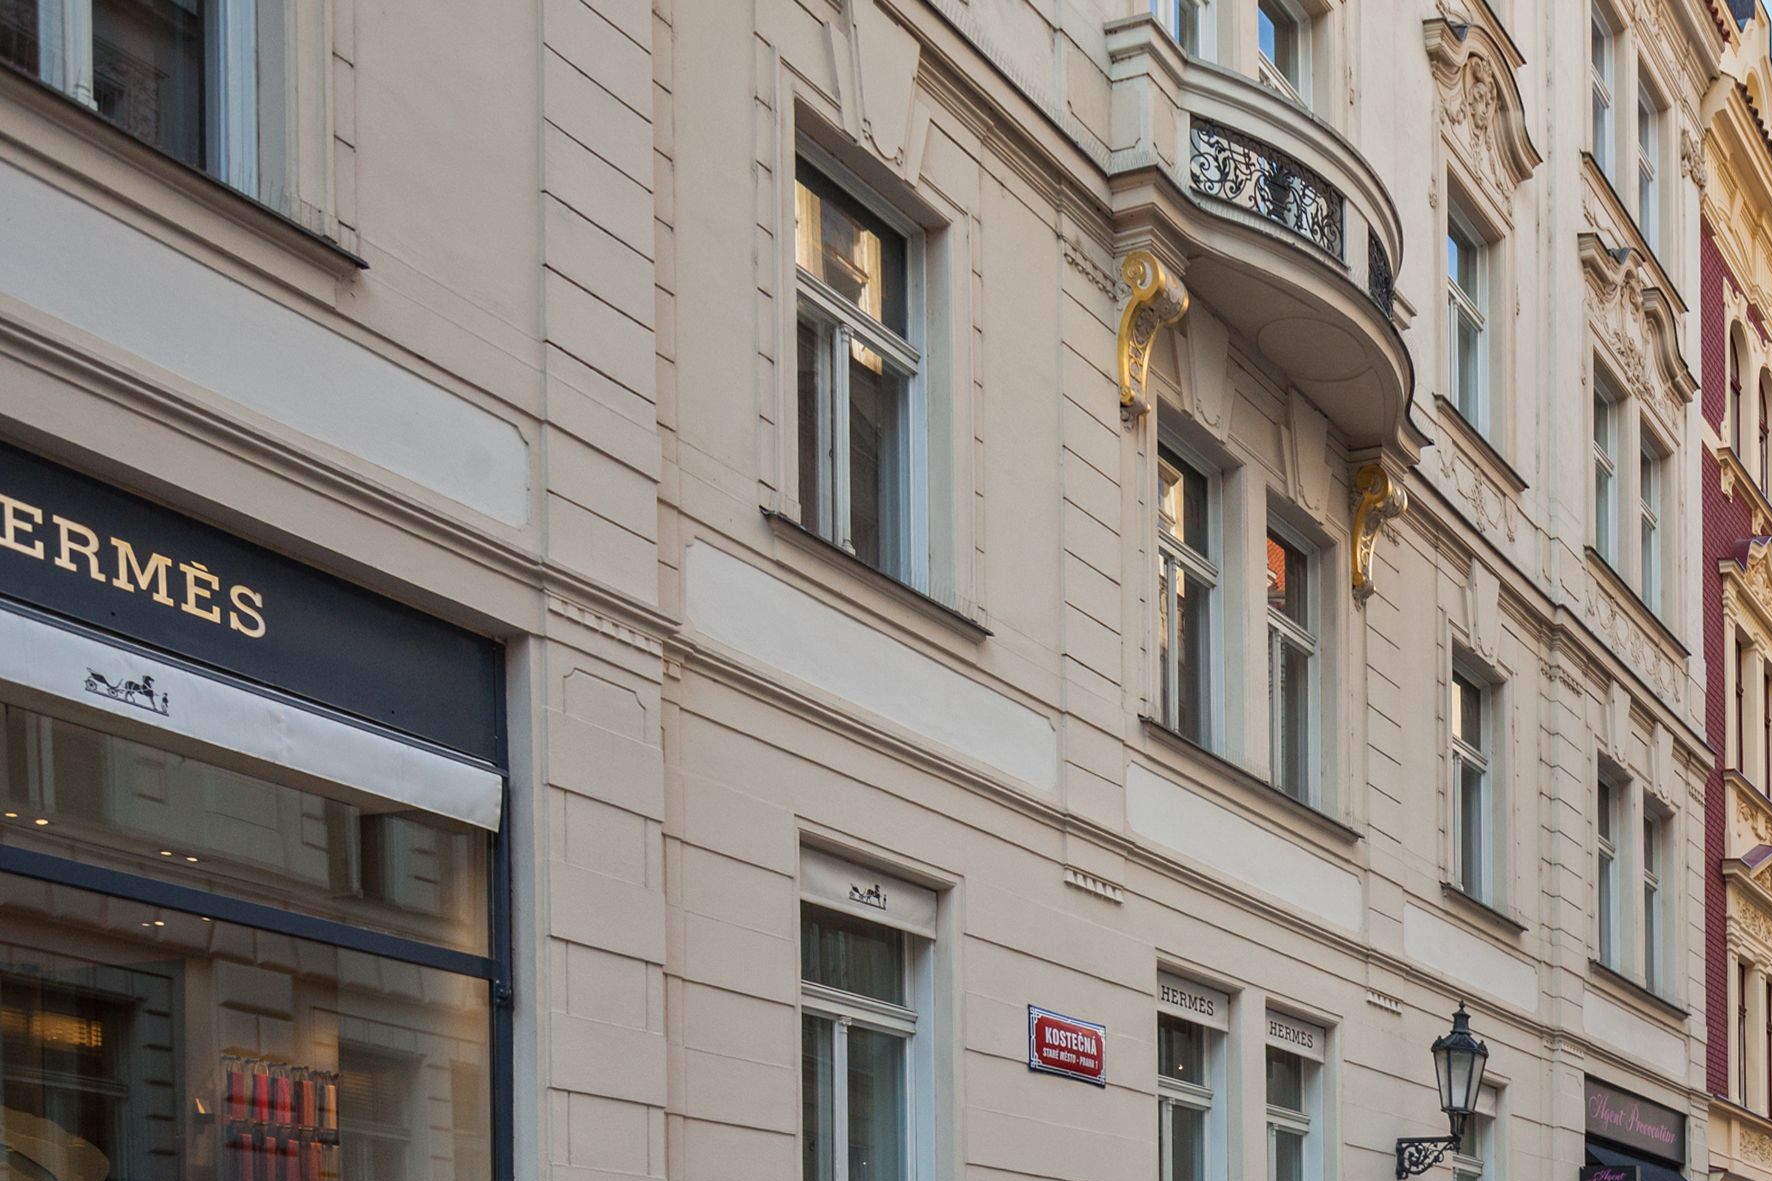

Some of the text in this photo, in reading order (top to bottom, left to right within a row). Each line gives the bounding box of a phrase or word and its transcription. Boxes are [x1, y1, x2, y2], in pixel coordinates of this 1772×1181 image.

[1161, 985, 1214, 1016] HERMÈS
[1045, 1026, 1097, 1056] KOSTEČNÁ
[1269, 1020, 1313, 1049] HERMÈS
[1589, 1094, 1678, 1144] Agent Provocateur
[1593, 1168, 1626, 1181] Agent
